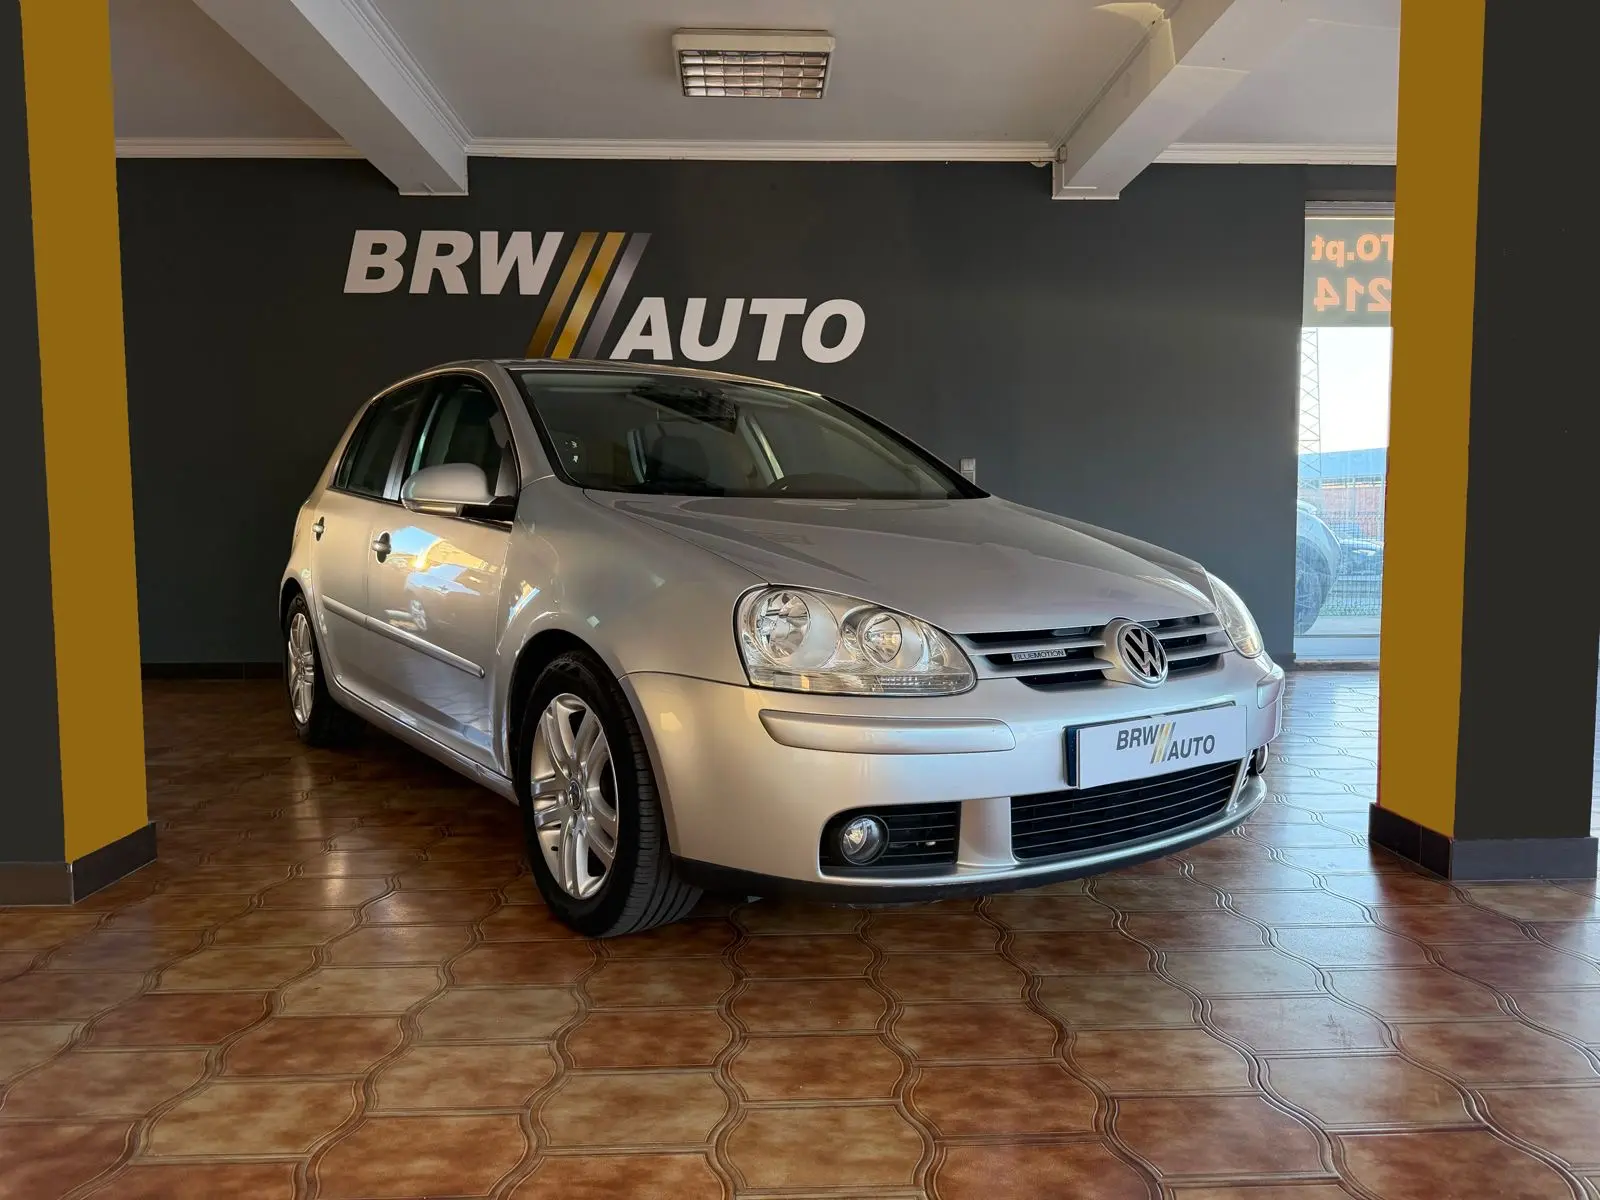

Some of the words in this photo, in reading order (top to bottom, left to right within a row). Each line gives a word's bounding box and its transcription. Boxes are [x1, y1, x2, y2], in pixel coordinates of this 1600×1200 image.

[342, 229, 565, 296] BRW
[608, 296, 866, 363] AUTO
[1013, 649, 1065, 660] BLUEMOTION
[1116, 723, 1160, 750] BRW
[1167, 734, 1216, 761] AUTO
